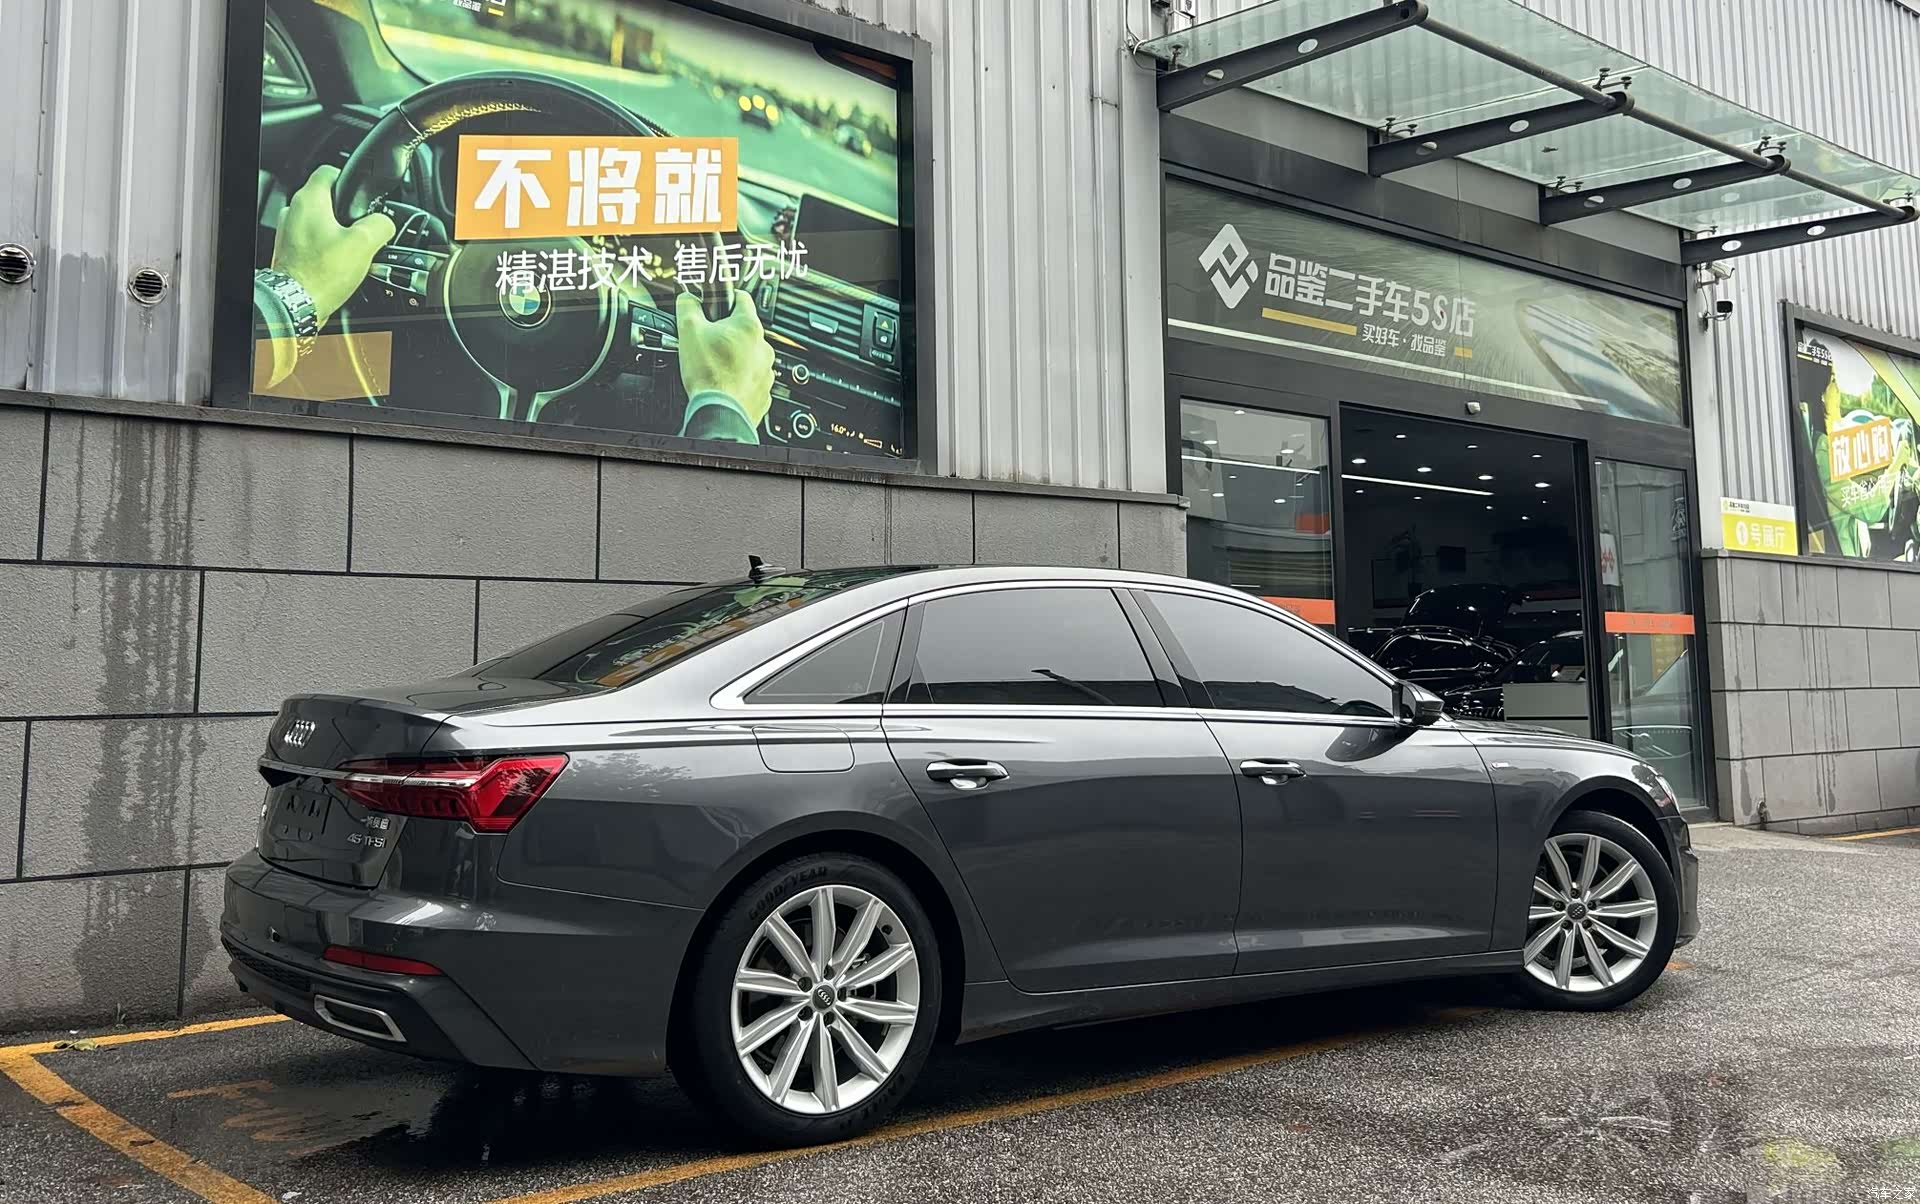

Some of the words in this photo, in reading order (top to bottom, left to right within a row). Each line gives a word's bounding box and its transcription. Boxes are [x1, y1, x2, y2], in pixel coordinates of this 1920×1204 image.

[474, 148, 722, 229] 不将就
[495, 245, 653, 296] 精湛技术
[674, 239, 809, 284] 售后无忧
[1264, 252, 1477, 338] 品鉴二手车5S店
